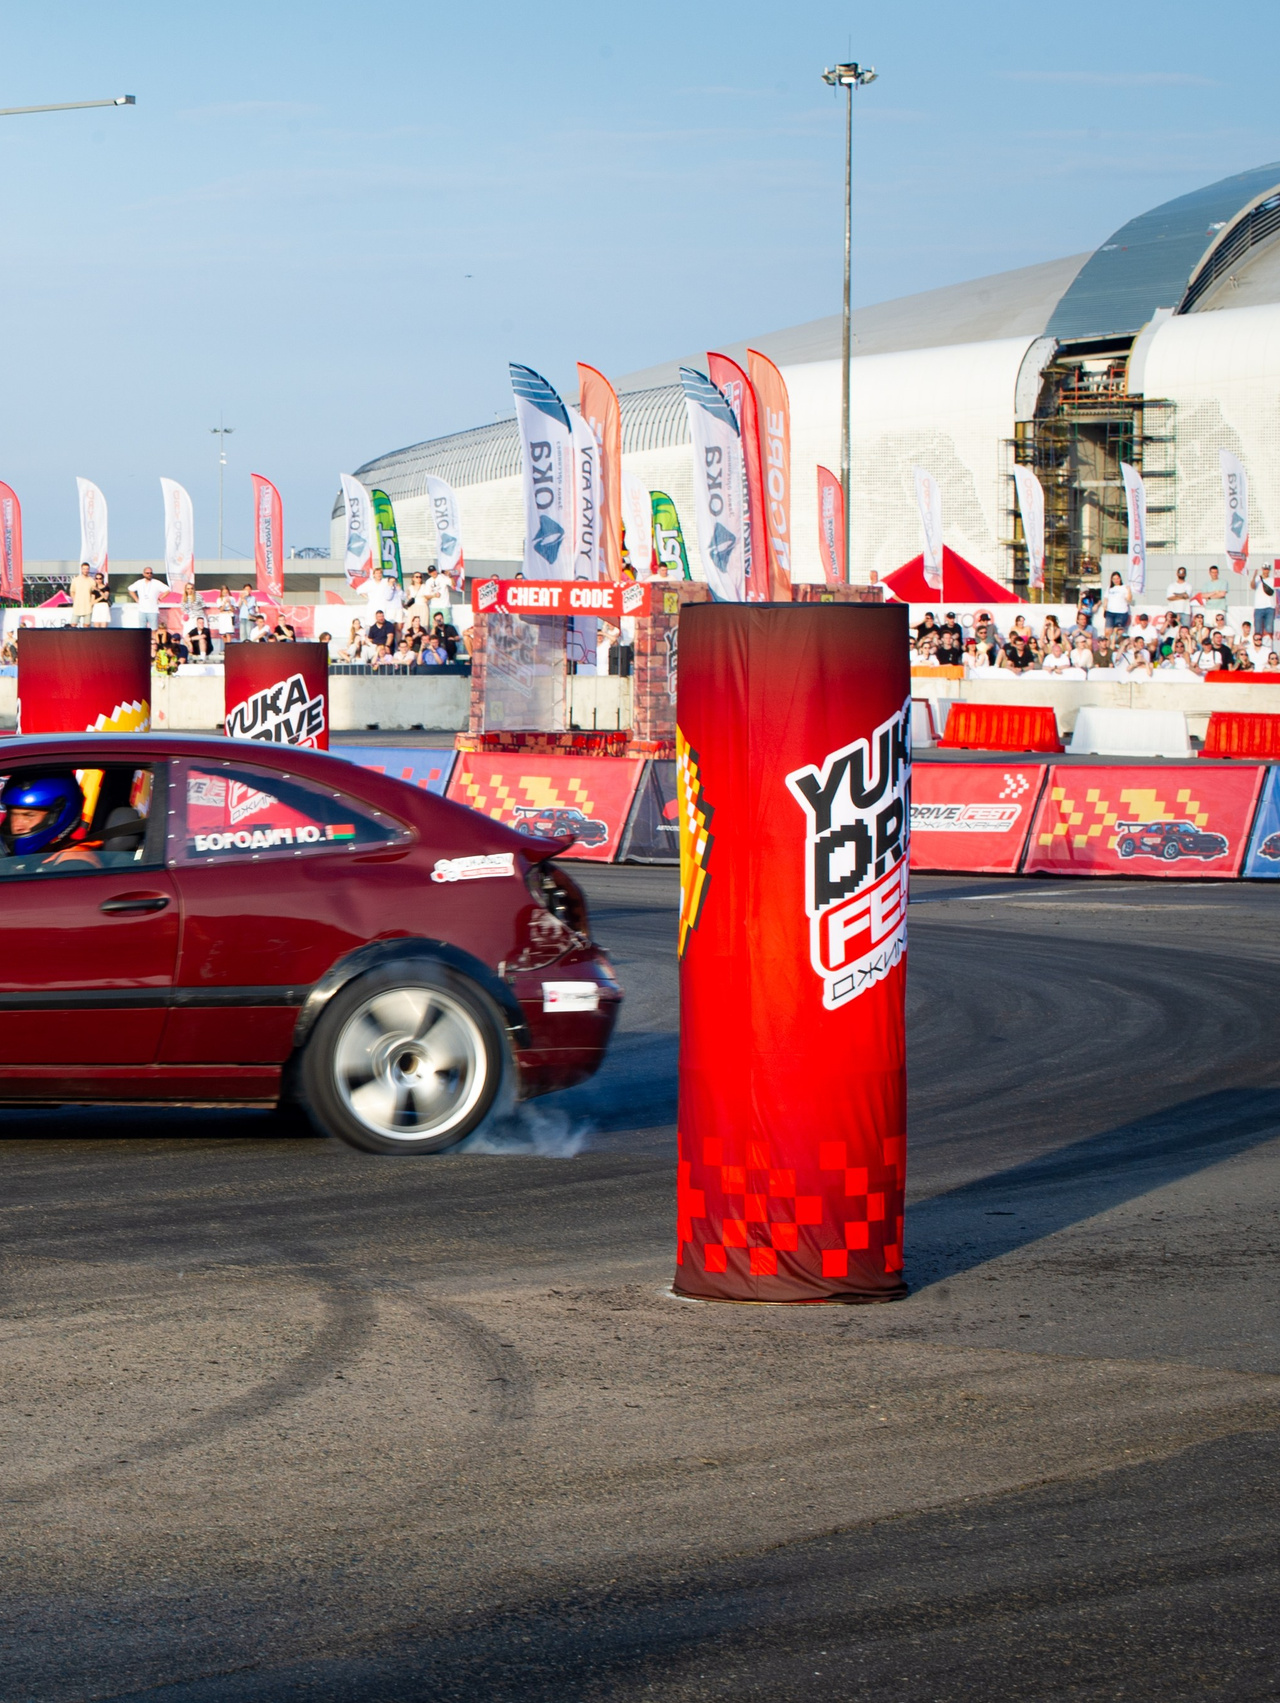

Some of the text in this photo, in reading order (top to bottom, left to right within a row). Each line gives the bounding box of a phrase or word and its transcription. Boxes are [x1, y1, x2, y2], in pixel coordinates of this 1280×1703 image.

[507, 587, 614, 608] CHEAT CODE
[227, 678, 308, 737] YUKA
[795, 702, 911, 835] YUK
[966, 808, 1016, 820] FEST
[194, 827, 294, 851] БОРОДИЧ
